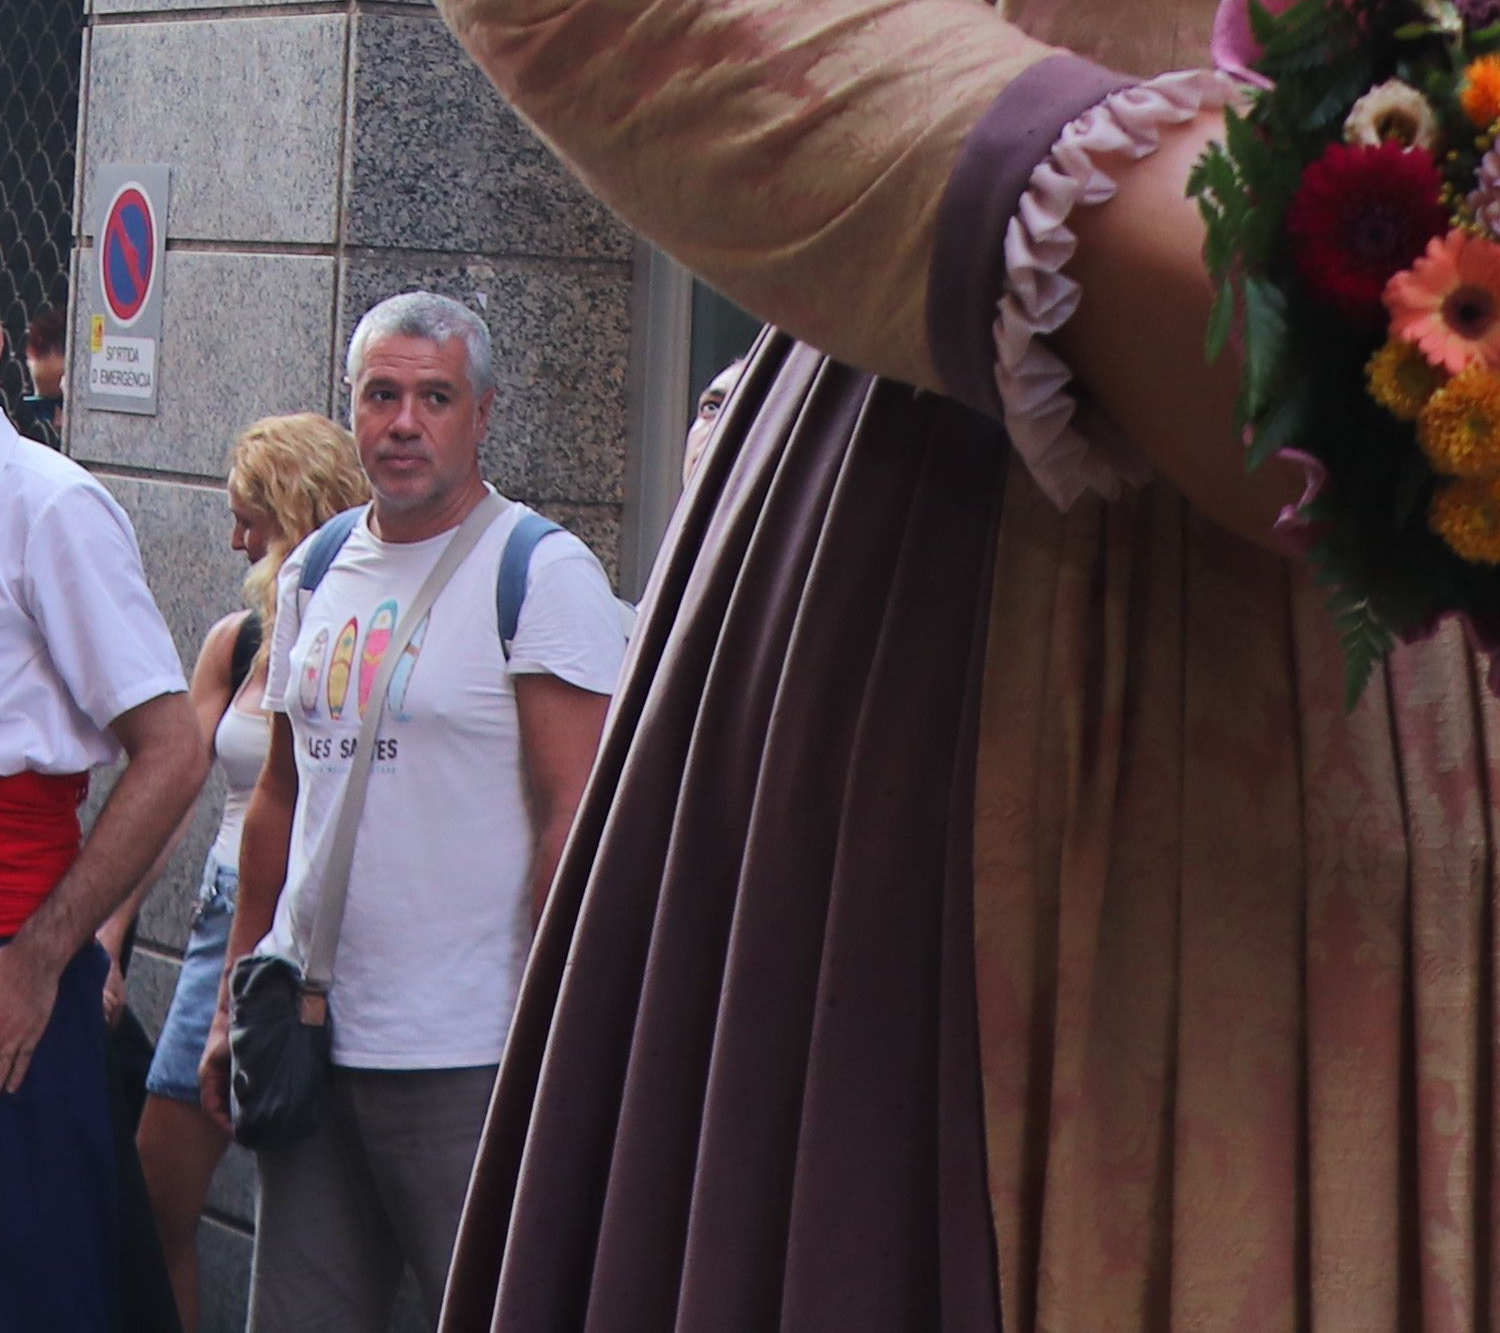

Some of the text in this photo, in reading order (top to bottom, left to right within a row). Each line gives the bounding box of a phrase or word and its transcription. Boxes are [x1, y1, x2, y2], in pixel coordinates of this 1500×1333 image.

[105, 345, 139, 363] SRTIDA
[308, 737, 332, 759] LES
[340, 737, 398, 761] SAES
